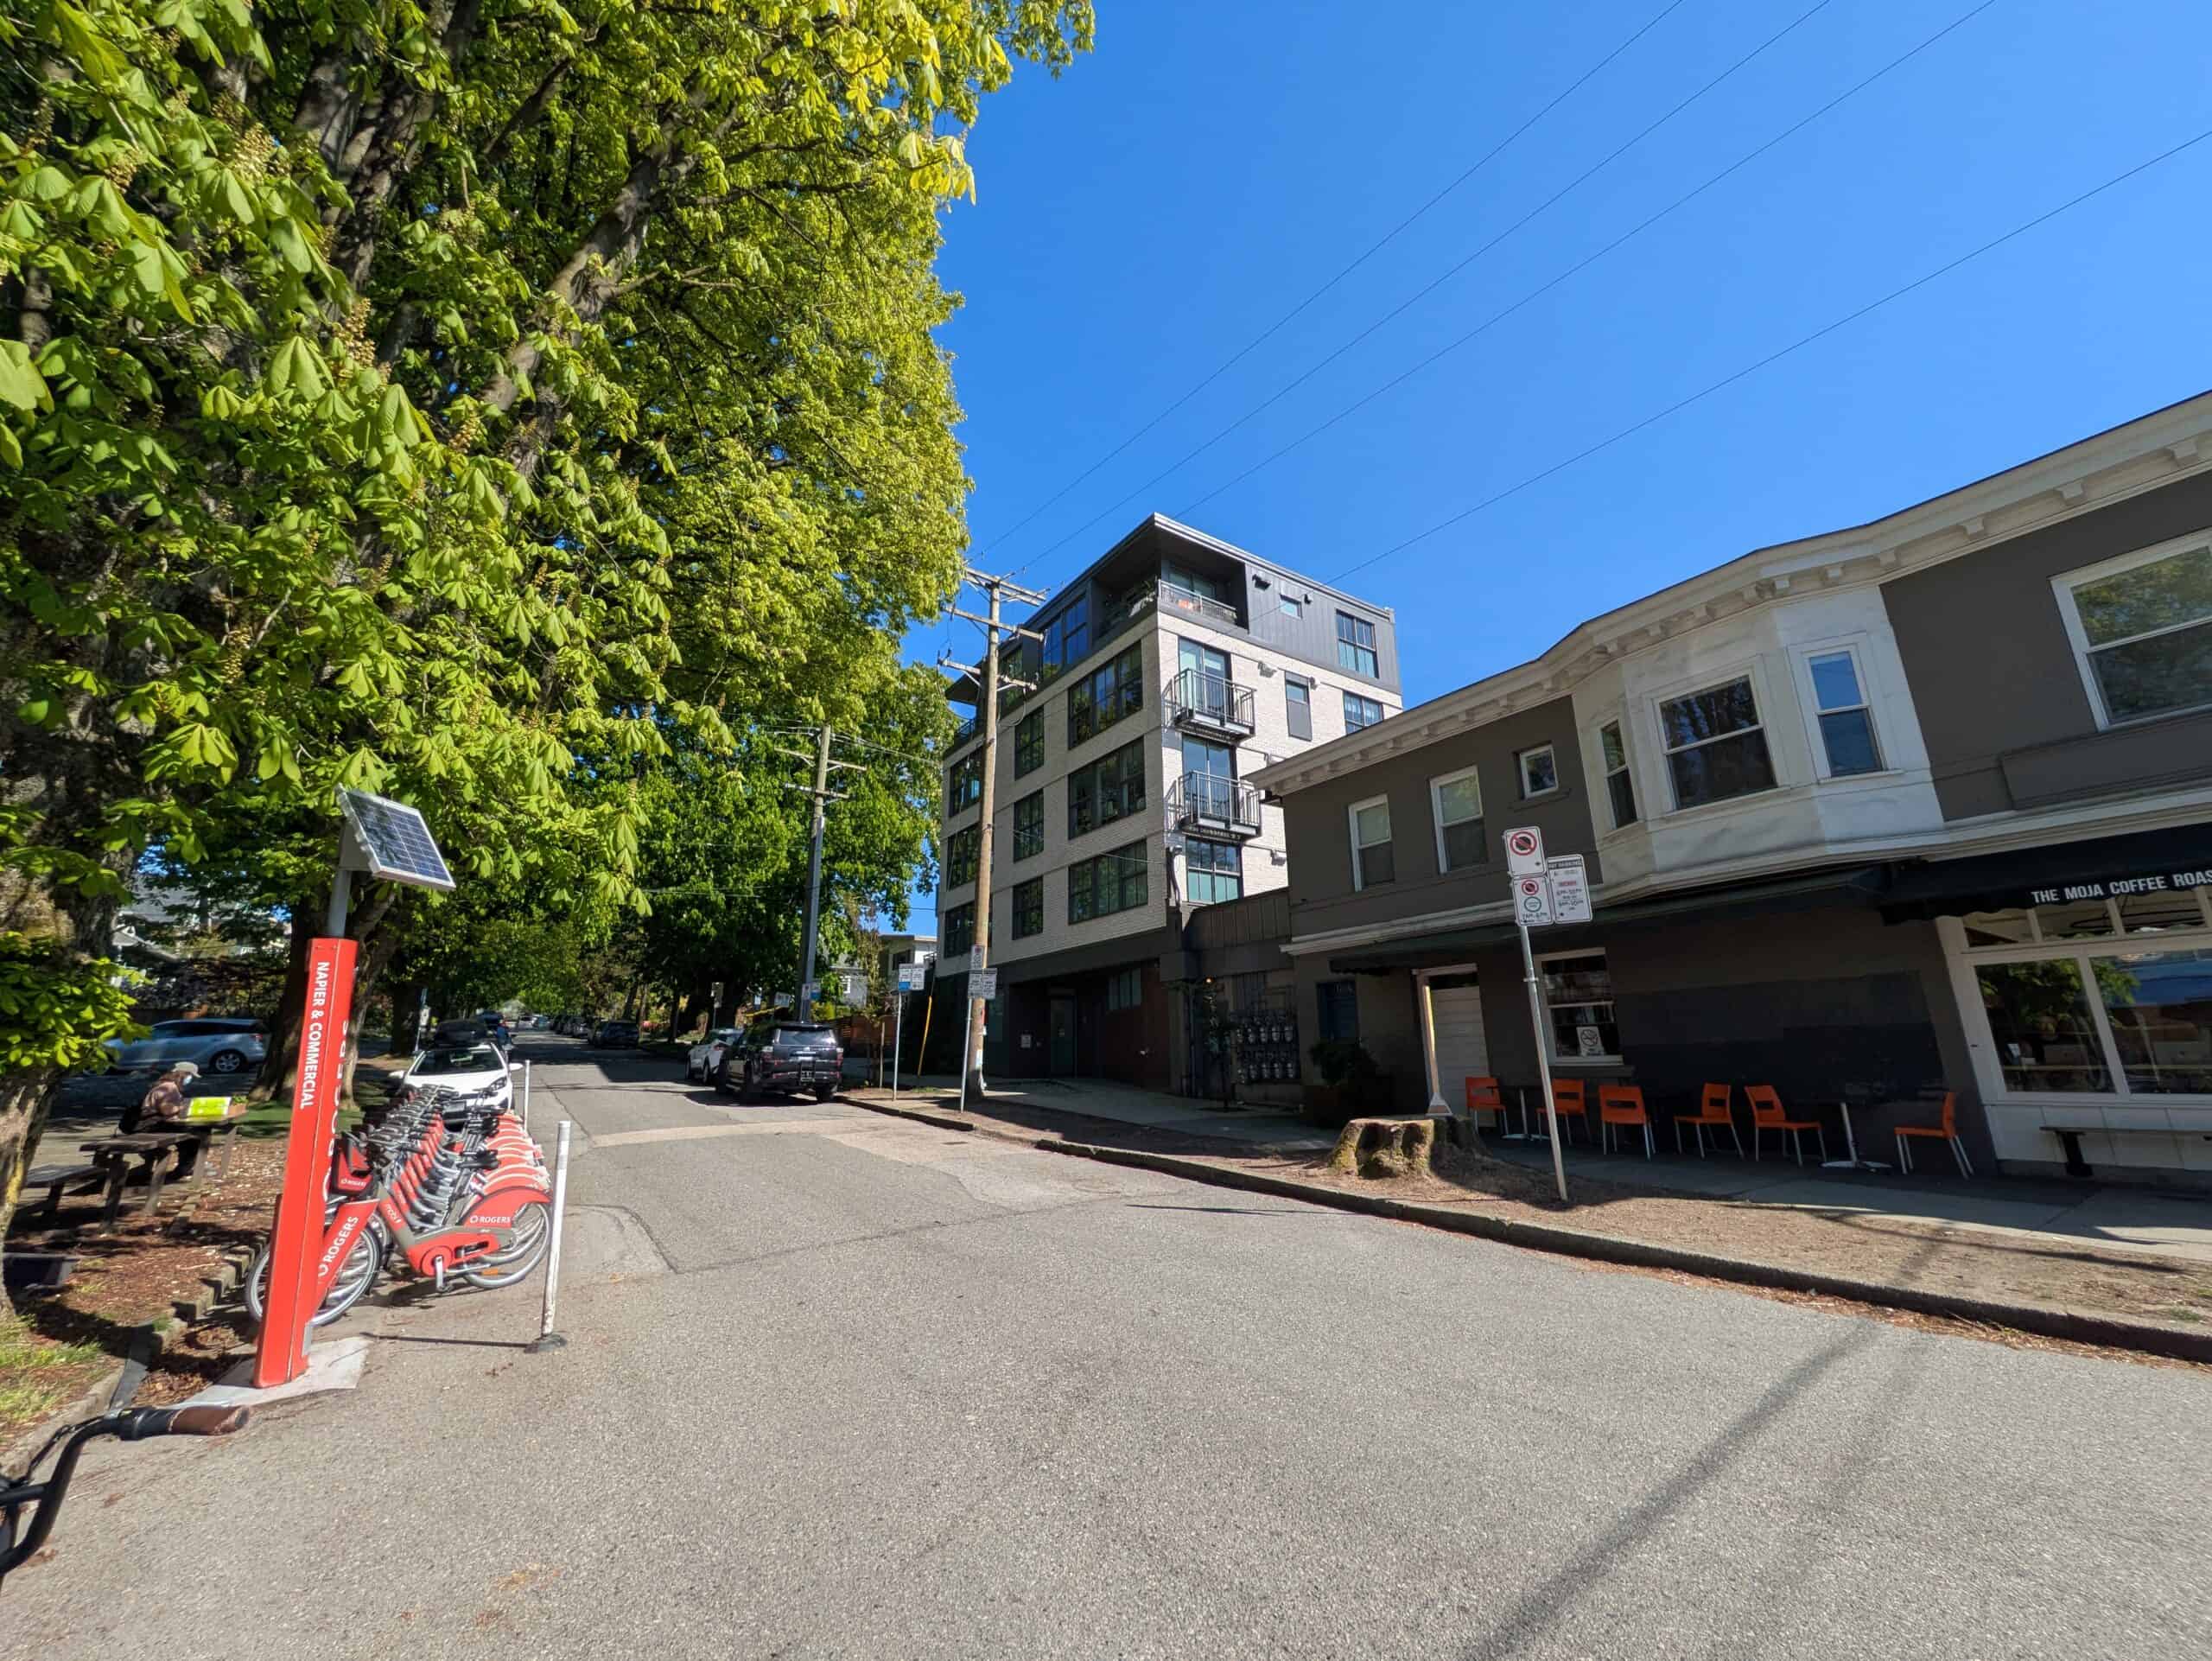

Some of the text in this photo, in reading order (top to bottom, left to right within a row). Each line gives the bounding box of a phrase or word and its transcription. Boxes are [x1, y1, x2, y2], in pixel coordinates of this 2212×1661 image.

[2031, 869, 2212, 904] THE MOJA COFFEE ROAS
[300, 961, 330, 1110] NAPIER & COMMERCIAL
[323, 1215, 359, 1263] ROGERS
[480, 1216, 512, 1225] ROGERS
